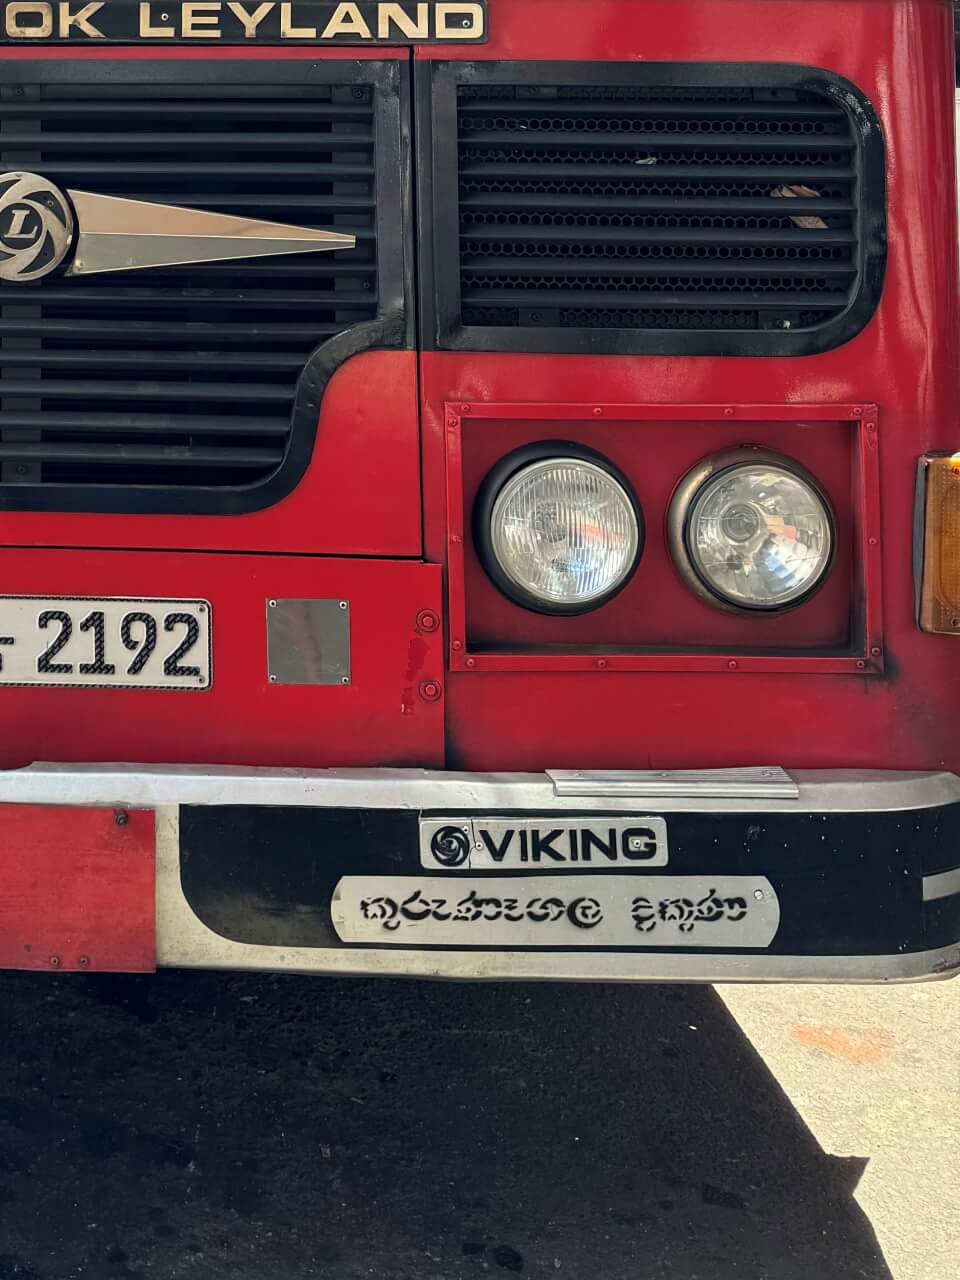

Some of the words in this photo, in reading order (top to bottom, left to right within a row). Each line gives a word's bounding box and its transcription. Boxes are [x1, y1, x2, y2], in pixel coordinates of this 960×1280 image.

[138, 1, 485, 40] LEYLAND
[37, 609, 201, 677] 2192
[478, 827, 658, 863] VIKING
